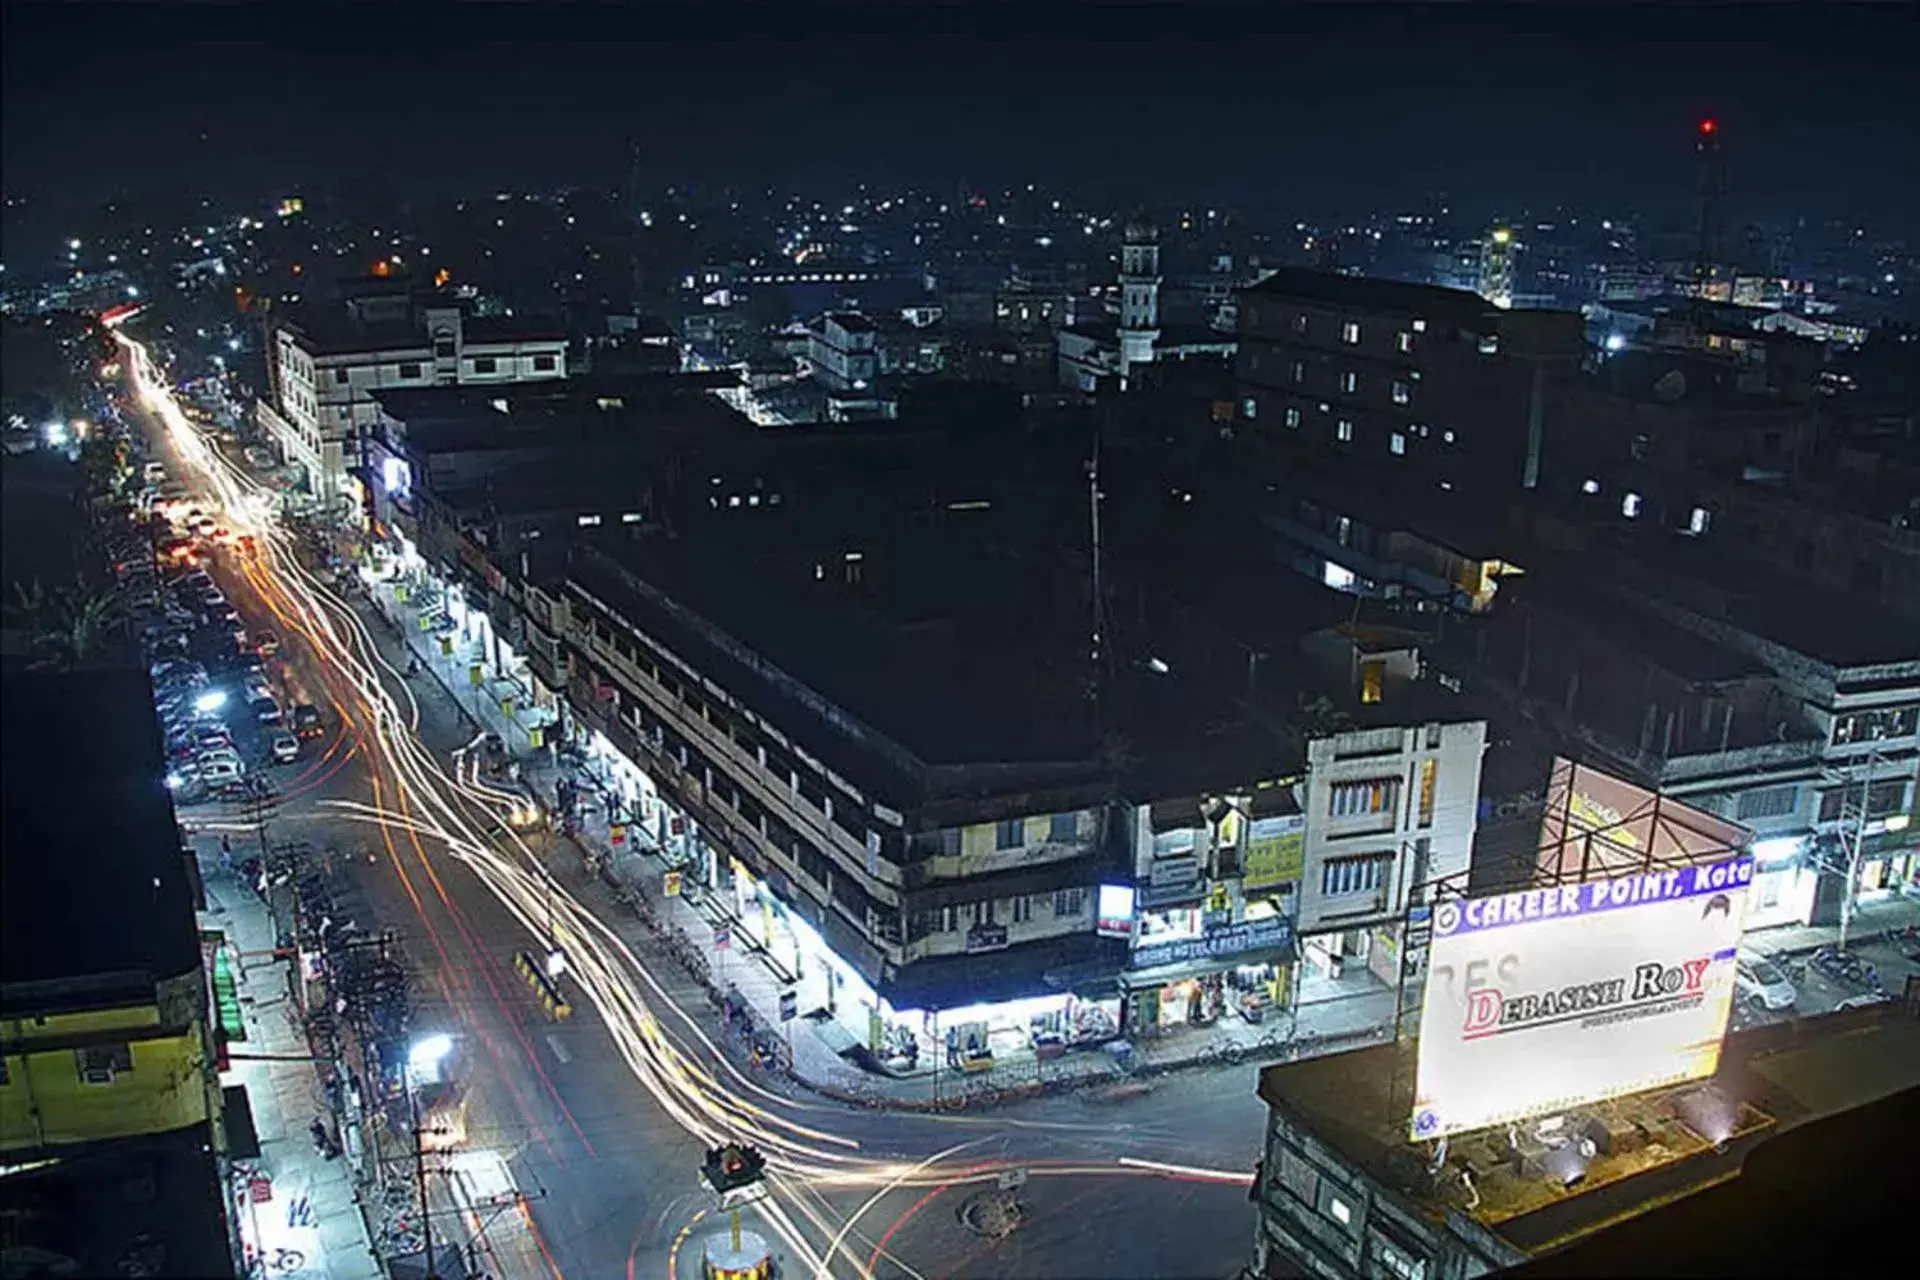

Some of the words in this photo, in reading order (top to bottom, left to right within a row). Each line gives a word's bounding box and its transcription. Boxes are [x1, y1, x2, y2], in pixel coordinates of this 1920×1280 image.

[1466, 884, 1580, 927] CAREER
[1591, 870, 1684, 908] POINT,
[1694, 862, 1751, 891] Kota
